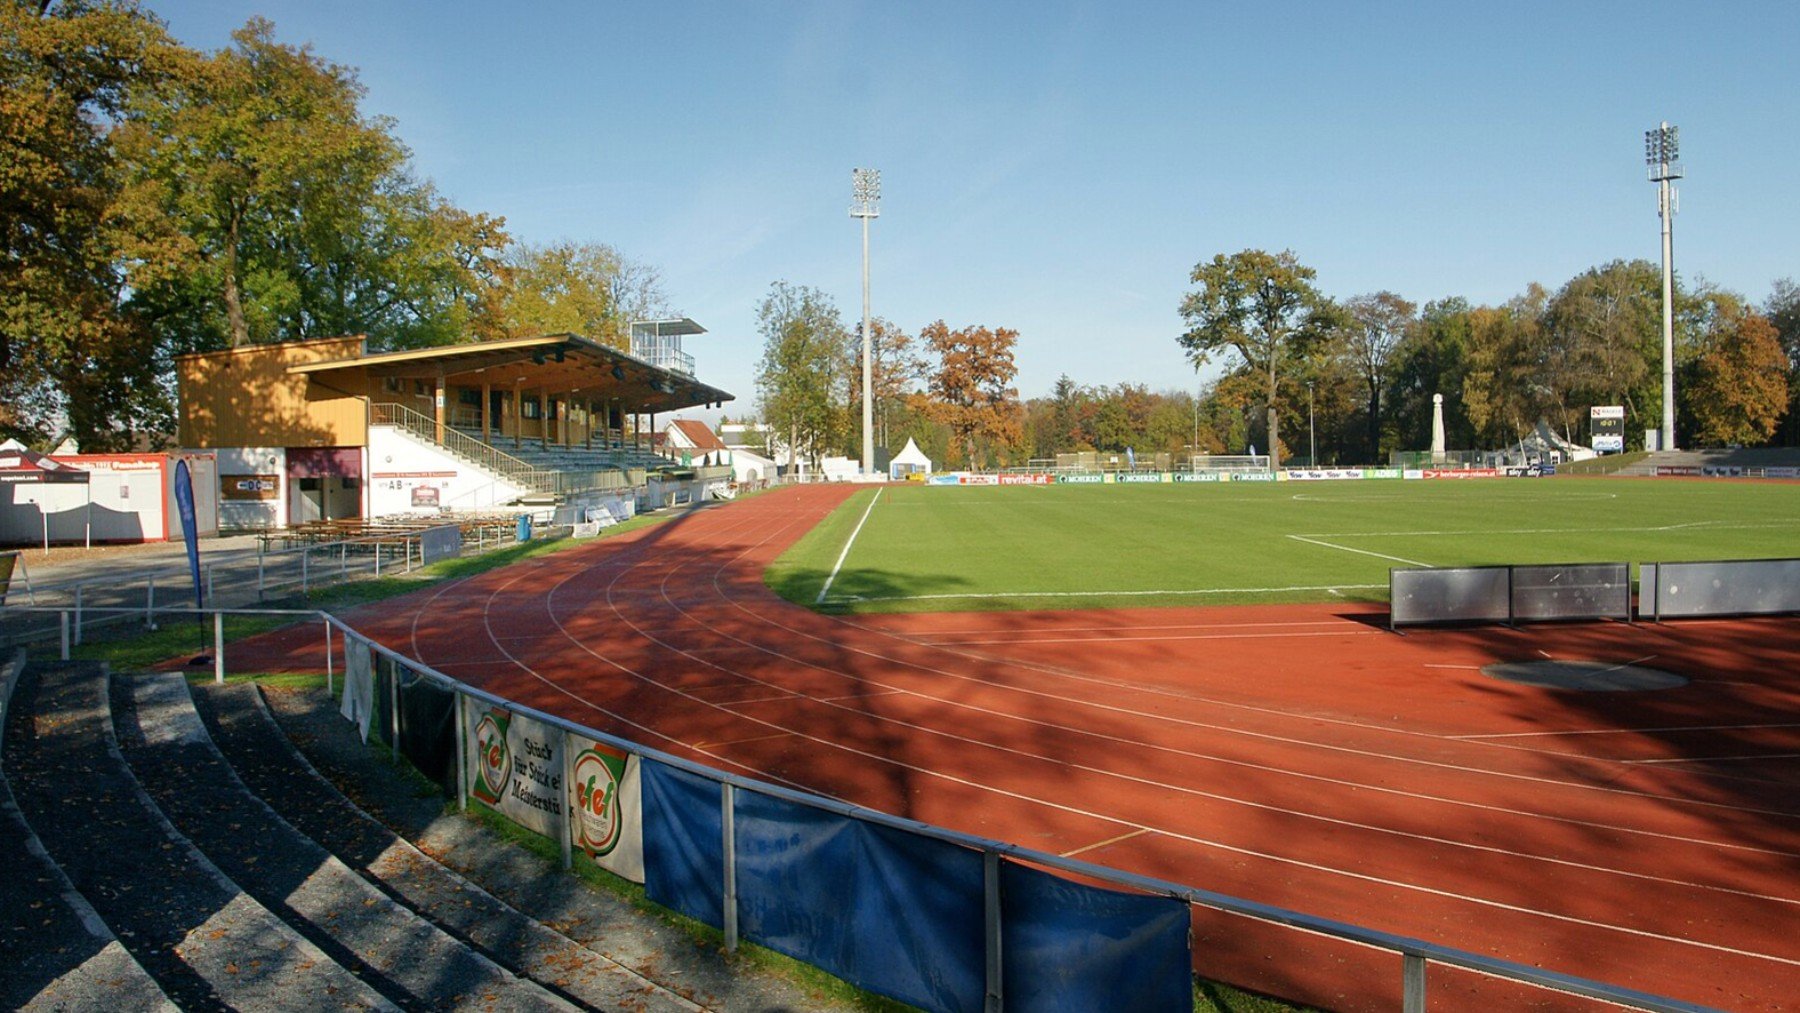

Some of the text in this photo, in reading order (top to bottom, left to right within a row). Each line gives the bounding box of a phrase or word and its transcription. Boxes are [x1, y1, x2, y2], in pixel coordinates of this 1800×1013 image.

[1508, 466, 1522, 477] sky
[1527, 465, 1541, 477] sky
[1002, 473, 1048, 484] revital.at
[256, 480, 262, 490] C
[389, 480, 395, 490] A
[397, 480, 402, 490] B
[524, 738, 552, 761] Stück
[529, 761, 550, 788] Stück
[512, 778, 575, 818] Meisterstük
[577, 775, 615, 820] efef
